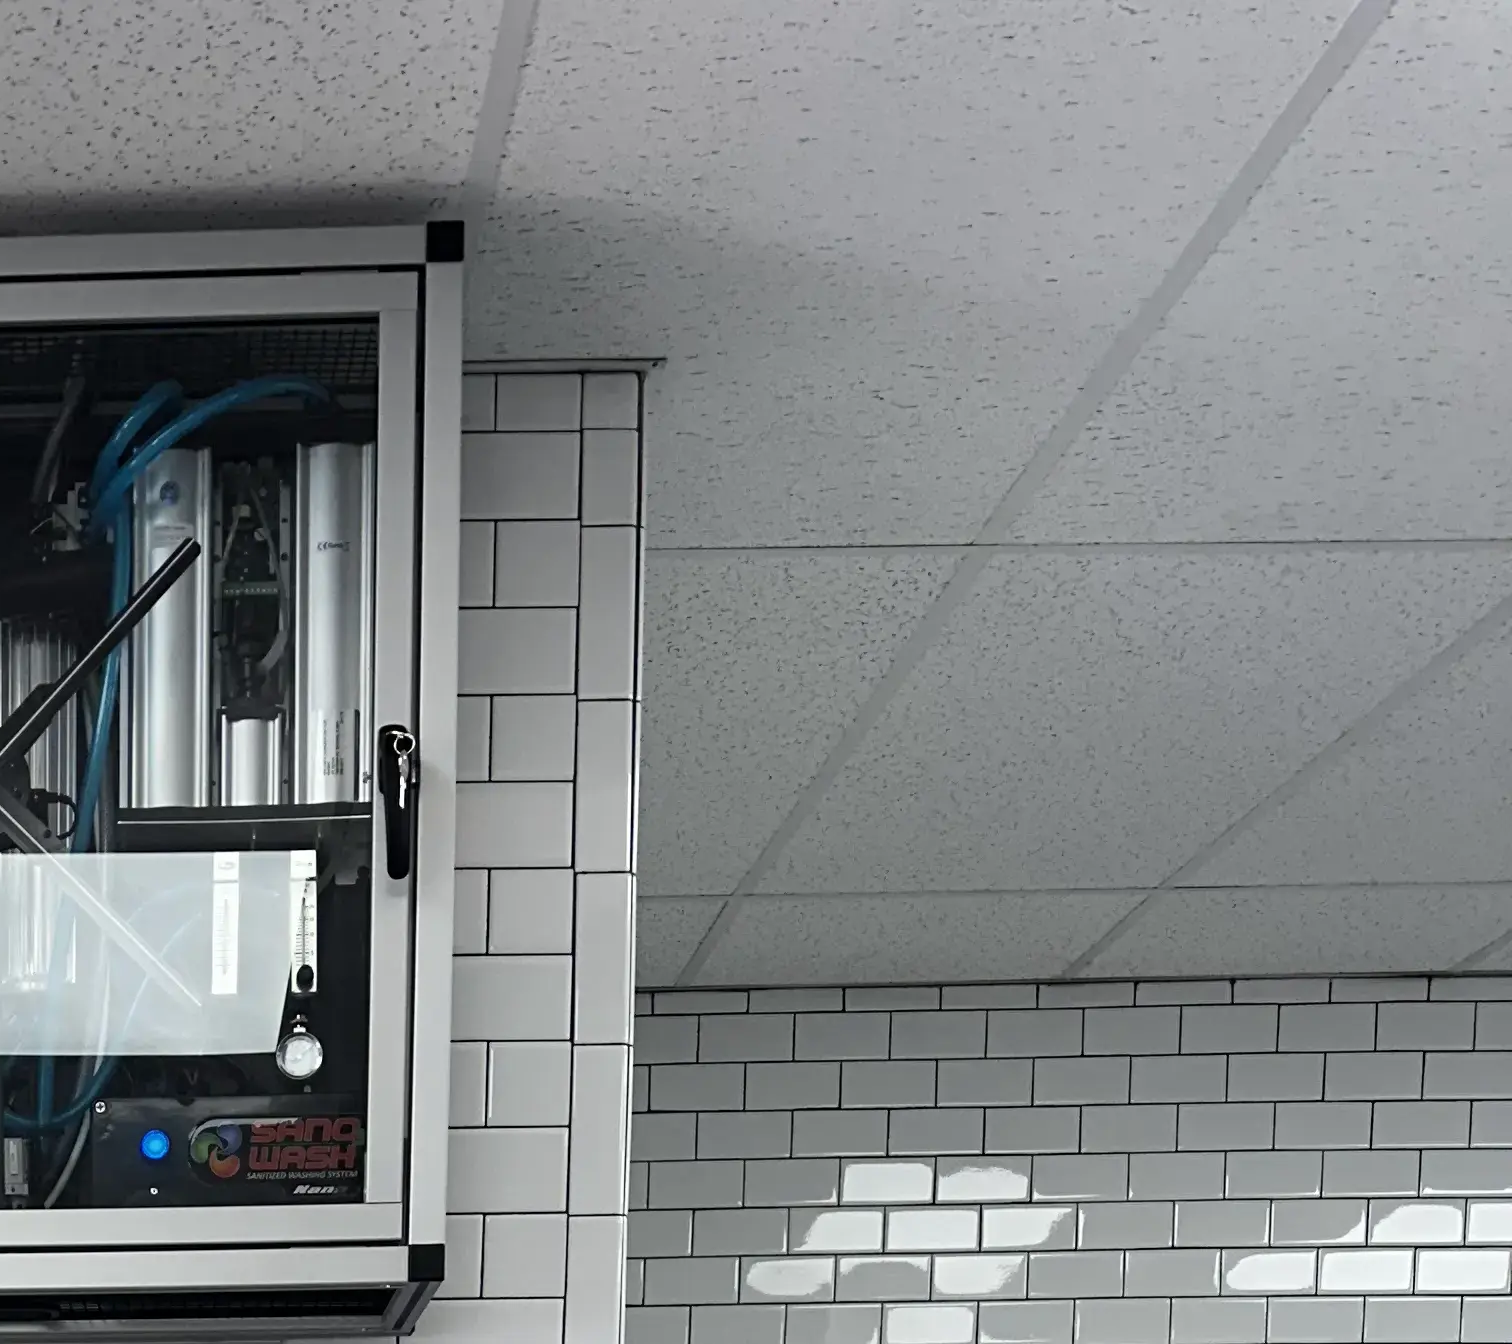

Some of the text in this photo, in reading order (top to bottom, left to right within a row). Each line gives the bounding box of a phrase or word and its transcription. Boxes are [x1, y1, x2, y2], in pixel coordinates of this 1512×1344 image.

[250, 1117, 361, 1143] SANO
[249, 1144, 356, 1171] WASH
[246, 1171, 358, 1180] SANITIZED WASHING SYSTEM
